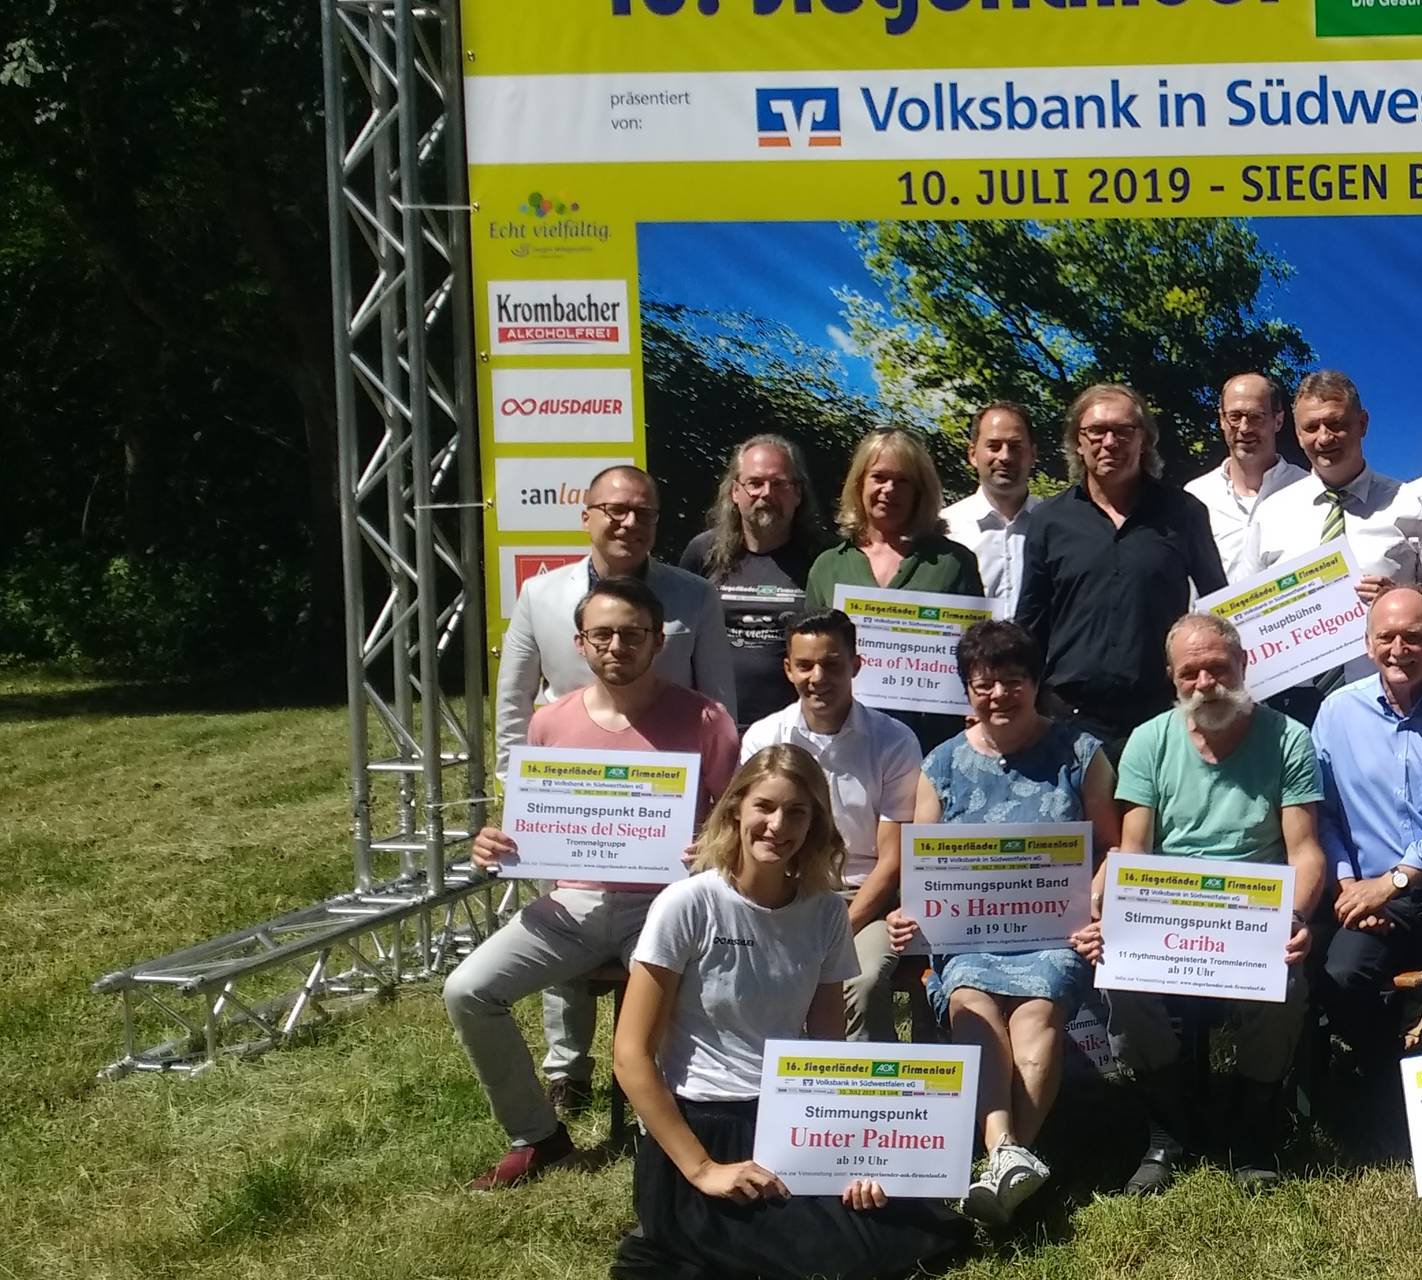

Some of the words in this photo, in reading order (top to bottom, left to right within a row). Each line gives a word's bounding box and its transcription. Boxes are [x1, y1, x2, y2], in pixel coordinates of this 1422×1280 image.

[610, 91, 690, 109] präsentiert
[861, 79, 1141, 132] Volksbank
[1159, 79, 1206, 128] in
[611, 117, 643, 130] von:
[898, 170, 960, 206] 10.
[976, 169, 1069, 205] JULI
[1089, 166, 1191, 203] 2019
[1210, 184, 1225, 192] -
[1242, 164, 1387, 201] SIEGEN
[490, 222, 526, 239] Echt
[533, 219, 611, 241] vielfältig.
[497, 294, 620, 322] Krombacher
[507, 328, 611, 338] ALKOHOLFREI
[539, 399, 622, 414] AUSDAUER
[1258, 602, 1322, 635] Hauptbühne
[1260, 640, 1290, 659] Dr.
[1290, 602, 1365, 646] Feelgood
[855, 638, 946, 656] timmungspunkt
[886, 657, 902, 669] of
[906, 657, 958, 674] Madne
[882, 675, 896, 685] ab
[901, 676, 913, 687] 19
[917, 678, 940, 689] Uhr
[528, 765, 540, 773] 16.
[543, 765, 601, 777] Siegerländer
[631, 769, 680, 779] Firmenlauf
[527, 803, 635, 818] Stimmungspunkt
[638, 807, 671, 818] Band
[515, 819, 587, 835] Bateristas
[591, 822, 613, 836] del
[617, 824, 666, 840] Siegtal
[566, 838, 626, 848] Trommelgruppe
[920, 842, 934, 851] 16.
[937, 841, 997, 852] Siegerländer
[571, 850, 583, 858] ab
[586, 850, 596, 858] 19
[600, 851, 618, 859] Uhr
[925, 879, 1032, 892] Stimmungspunkt
[1036, 878, 1069, 888] Band
[1125, 873, 1138, 881] 16.
[1141, 873, 1199, 886] Siegerländer
[1227, 880, 1276, 892] Firmenlauf
[968, 898, 1070, 918] Harmony
[966, 925, 981, 935] ab
[986, 924, 999, 934] 19
[1003, 923, 1027, 933] Uhr
[1125, 911, 1231, 930] Stimmungspunkt
[1235, 920, 1268, 932] Band
[1164, 932, 1225, 953] Cariba
[1129, 952, 1207, 963] rhythmusbegeisterte
[1210, 957, 1267, 969] Trommlerinnen
[1168, 966, 1180, 975] ab
[1183, 966, 1194, 975] 19
[1196, 967, 1215, 977] Uhr
[786, 1062, 800, 1071] 16.
[804, 1062, 869, 1075] Siegerländer
[875, 1064, 895, 1073] AOK
[902, 1064, 956, 1075] Firmenlauf
[859, 1079, 905, 1087] Südwestfalen
[805, 1106, 928, 1122] Stimmungspunkt
[790, 1127, 855, 1148] Unter
[862, 1128, 945, 1149] Palmen
[836, 1156, 849, 1165] ab
[853, 1156, 864, 1165] 19
[868, 1156, 888, 1166] Uhr
